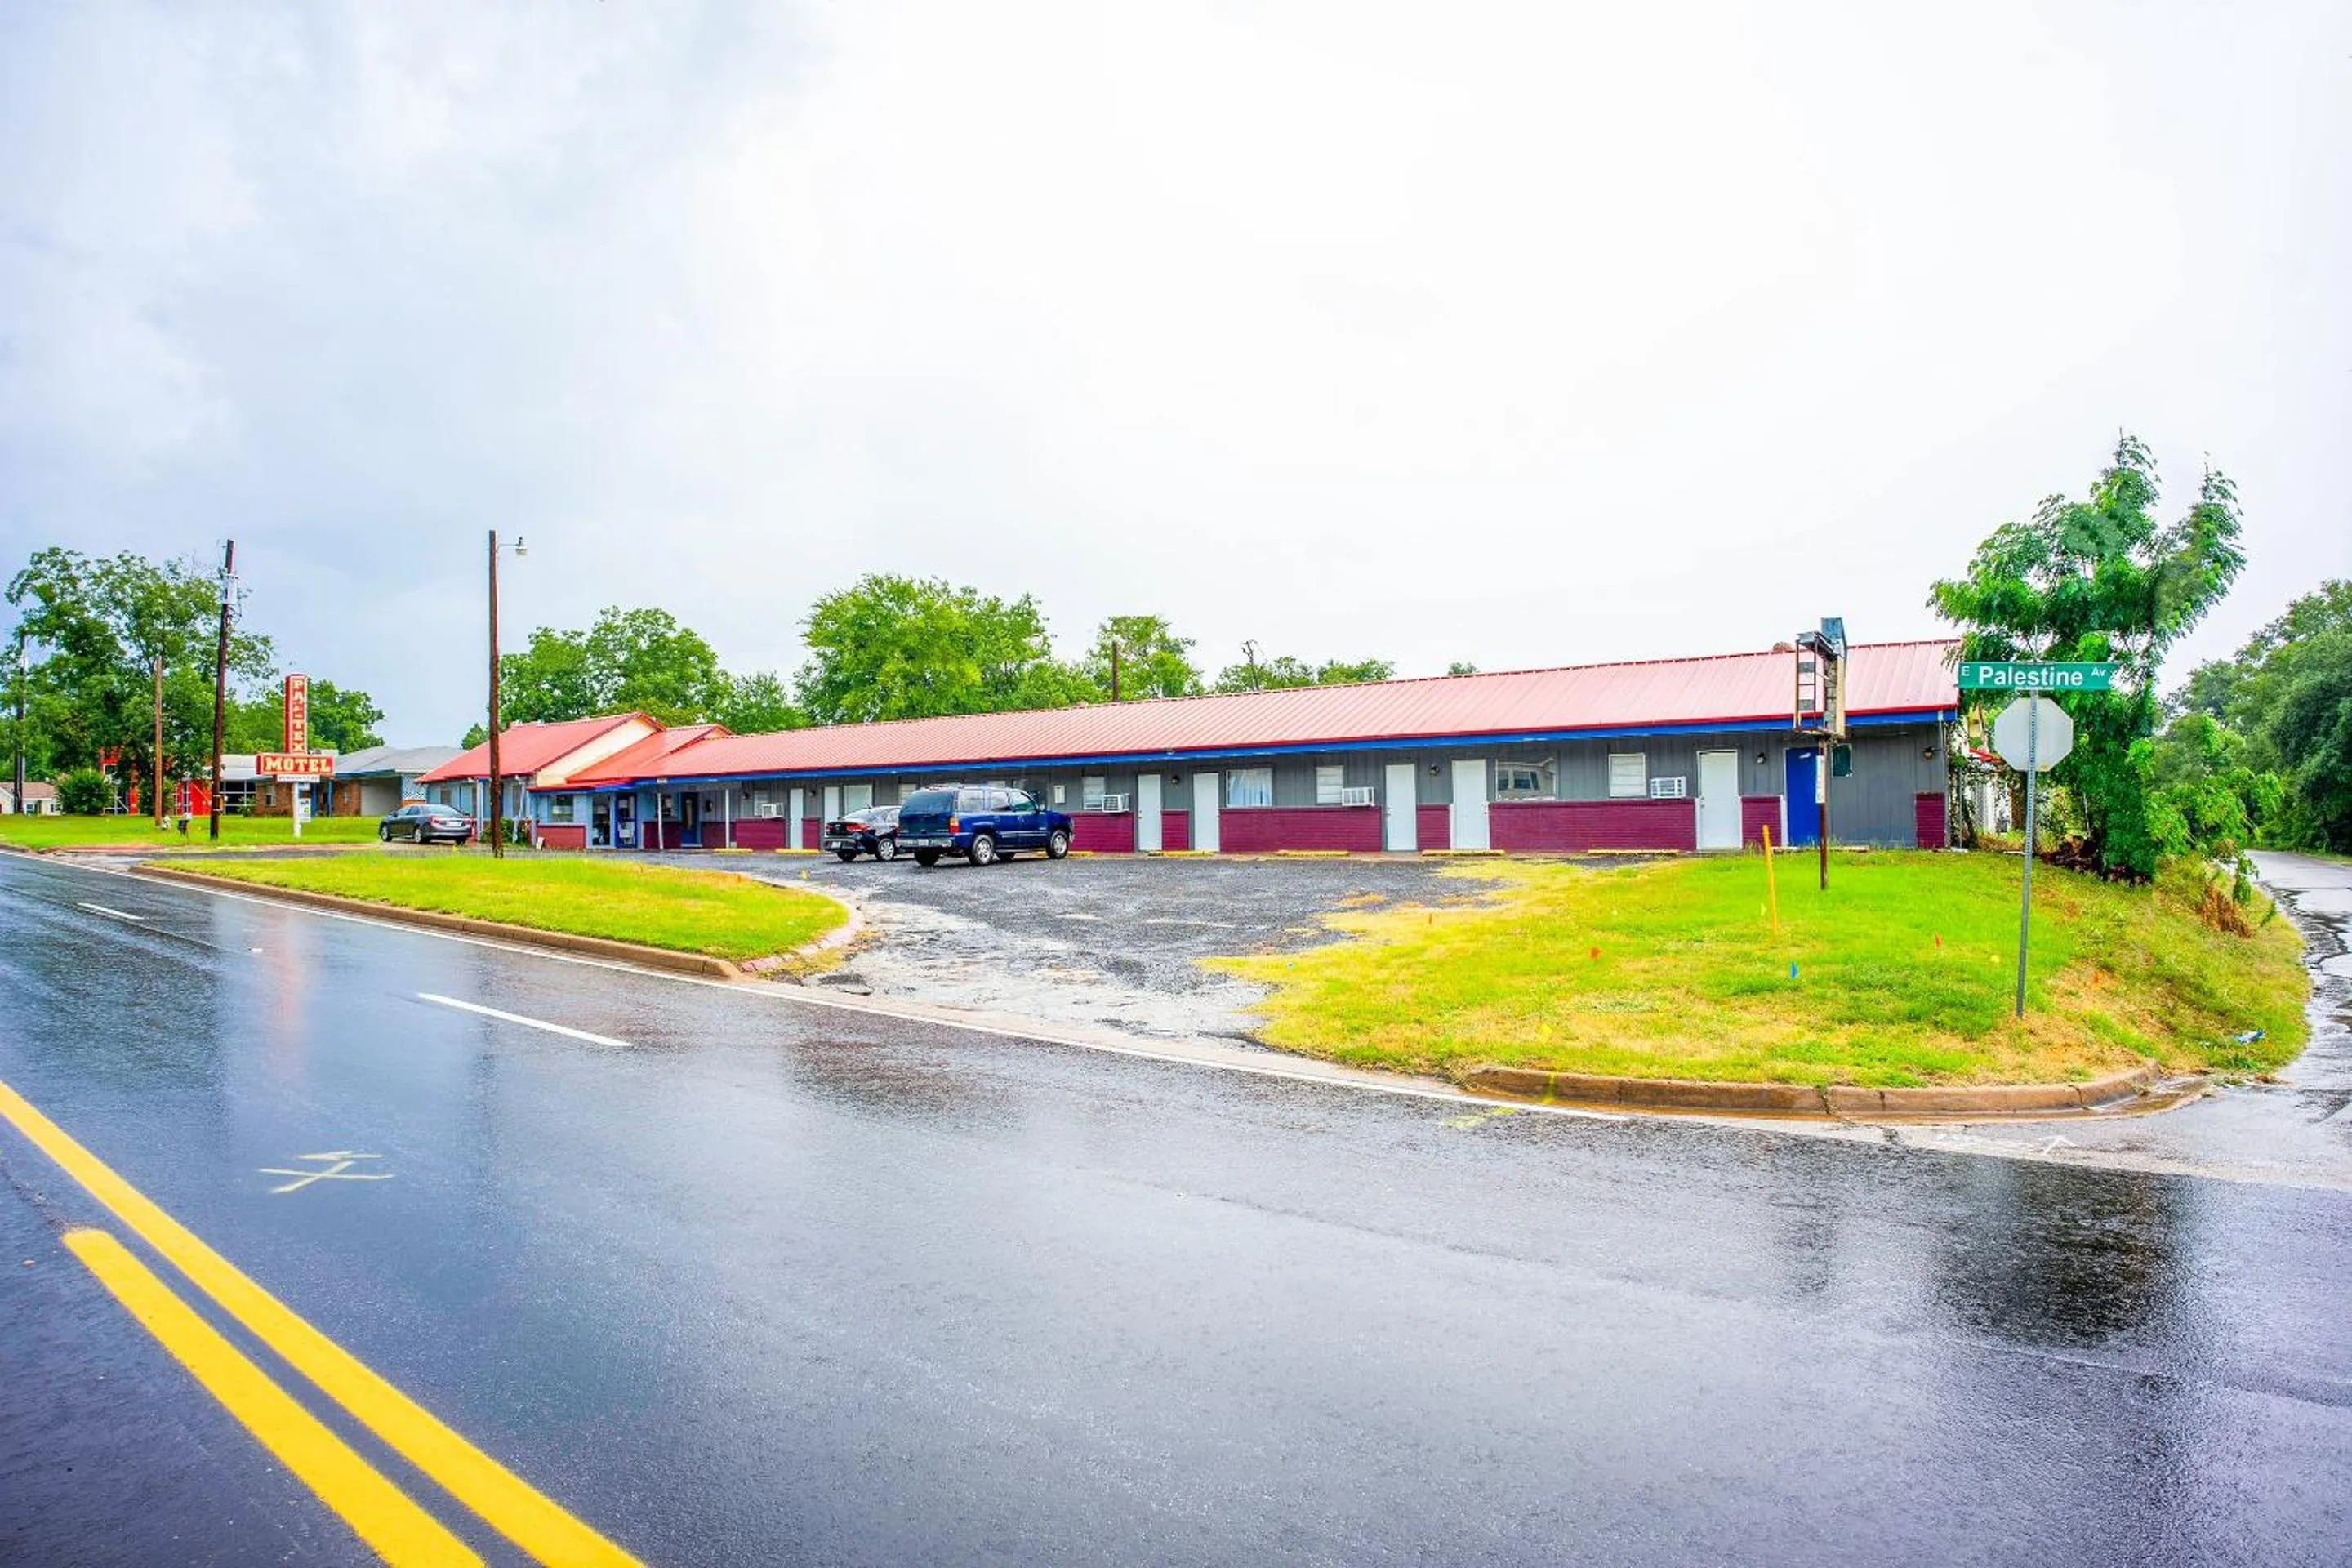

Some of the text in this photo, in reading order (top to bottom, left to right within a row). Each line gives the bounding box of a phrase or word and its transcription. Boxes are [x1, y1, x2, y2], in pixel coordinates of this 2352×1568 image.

[1961, 666, 1970, 677] E
[1979, 666, 2083, 686] Palestine
[265, 757, 331, 773] MOTEL
